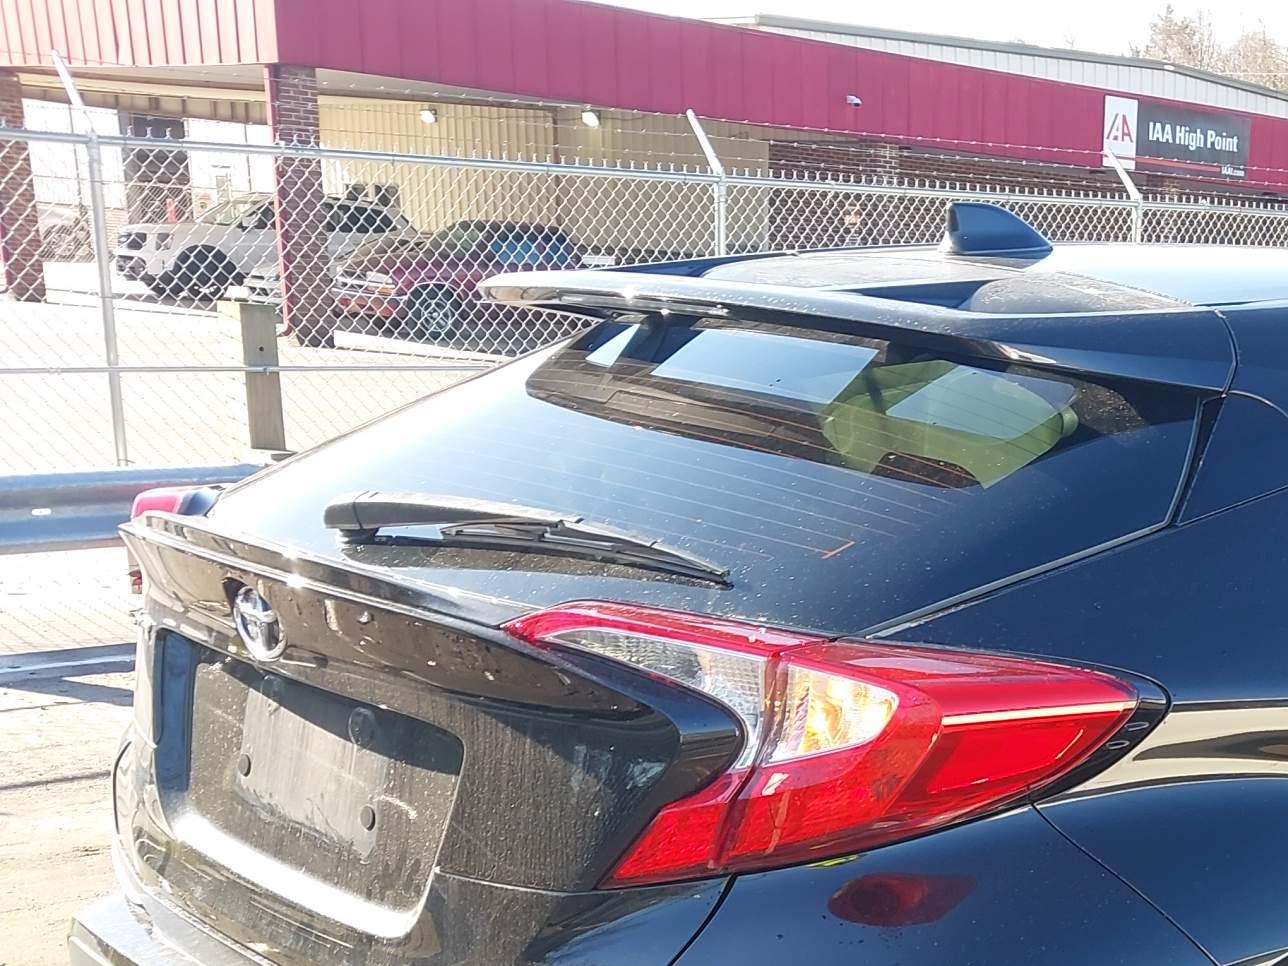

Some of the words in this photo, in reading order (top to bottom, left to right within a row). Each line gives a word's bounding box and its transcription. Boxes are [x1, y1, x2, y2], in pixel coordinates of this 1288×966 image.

[1148, 121, 1173, 144] IAA
[1175, 125, 1204, 151] High
[1206, 130, 1239, 153] Point
